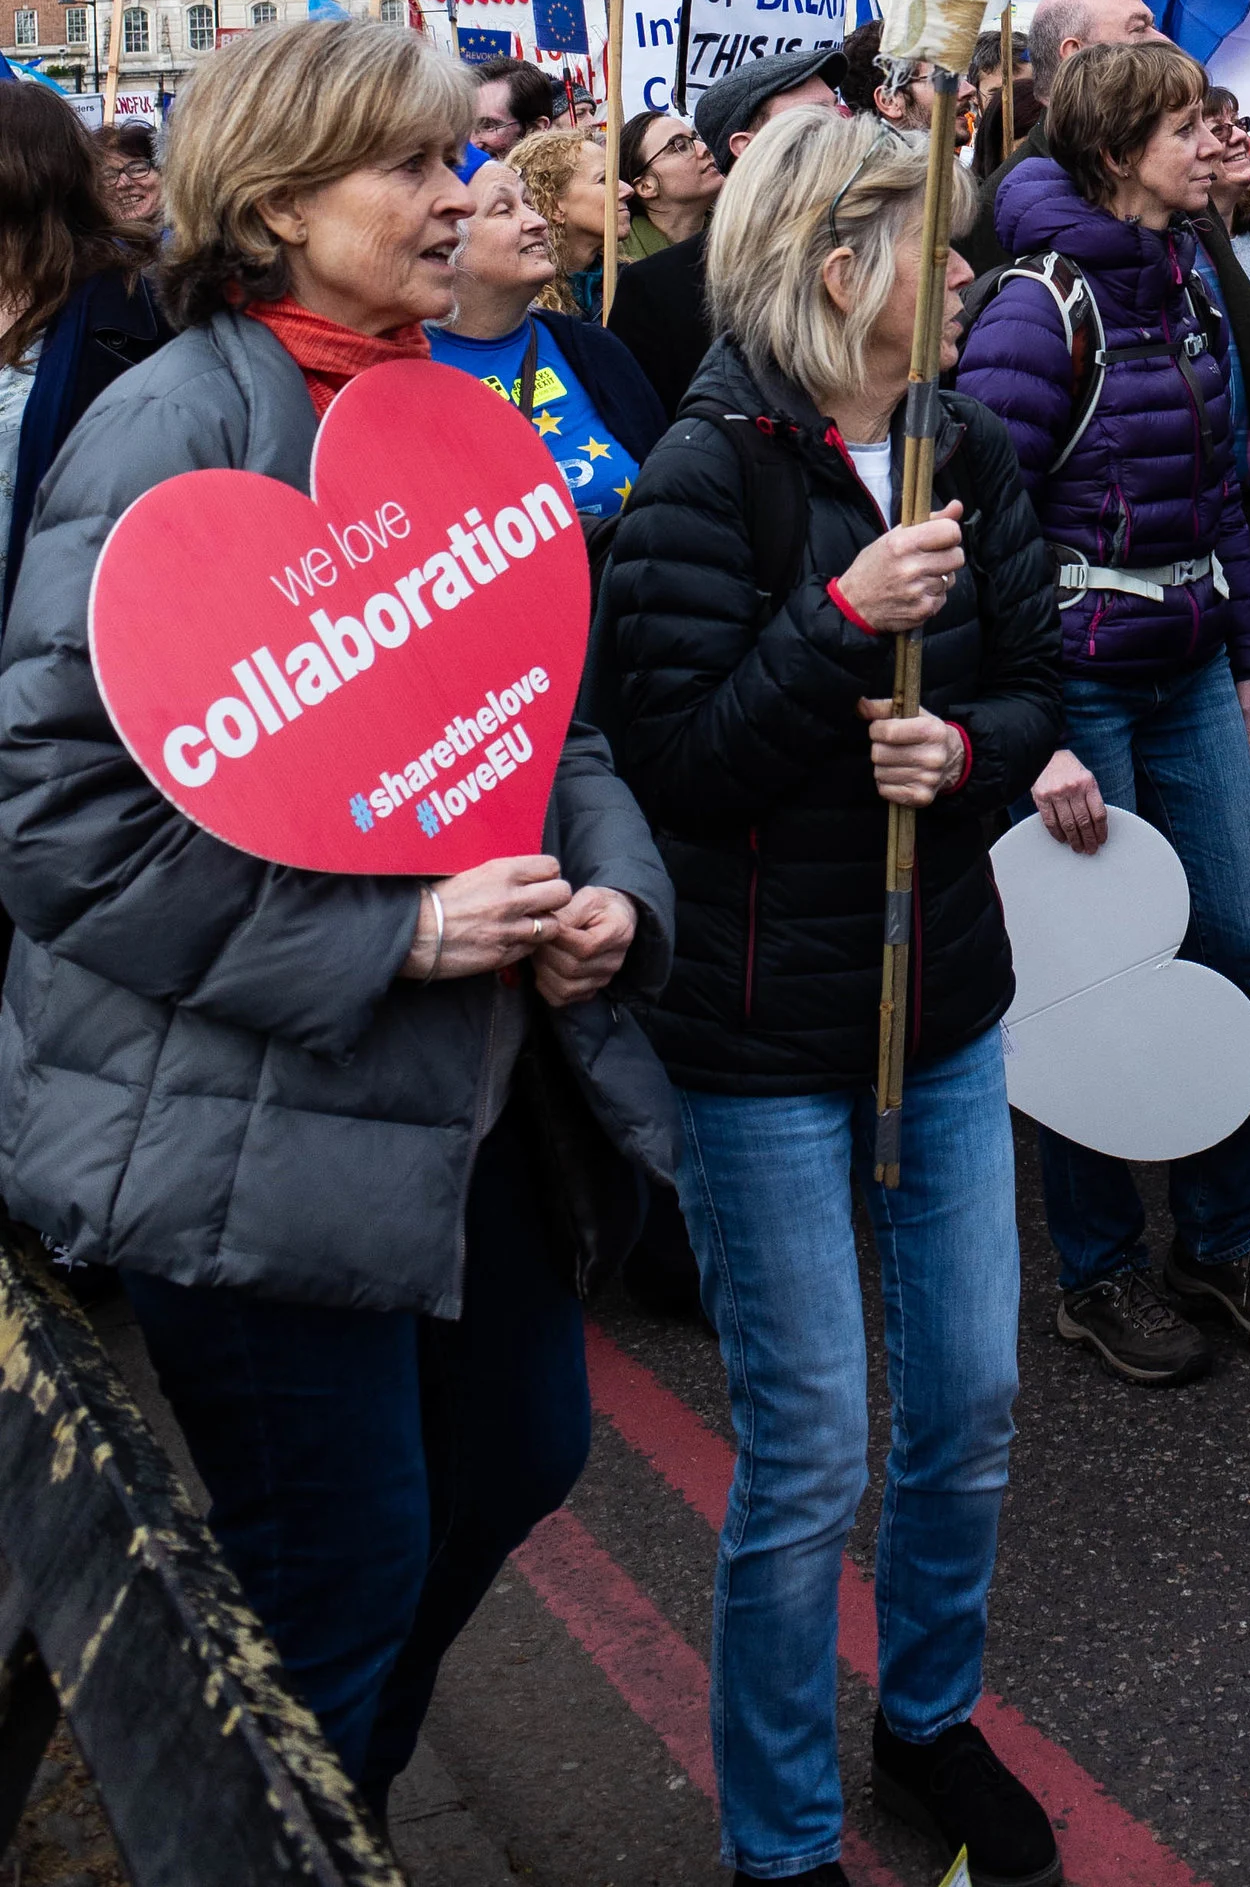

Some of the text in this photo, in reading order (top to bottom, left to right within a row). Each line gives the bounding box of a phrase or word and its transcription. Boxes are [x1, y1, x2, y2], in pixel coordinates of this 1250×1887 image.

[269, 500, 411, 607] we love
[162, 482, 573, 788] collaboration
[350, 666, 550, 832] #sharethelove
[416, 724, 534, 839] #loveEU
